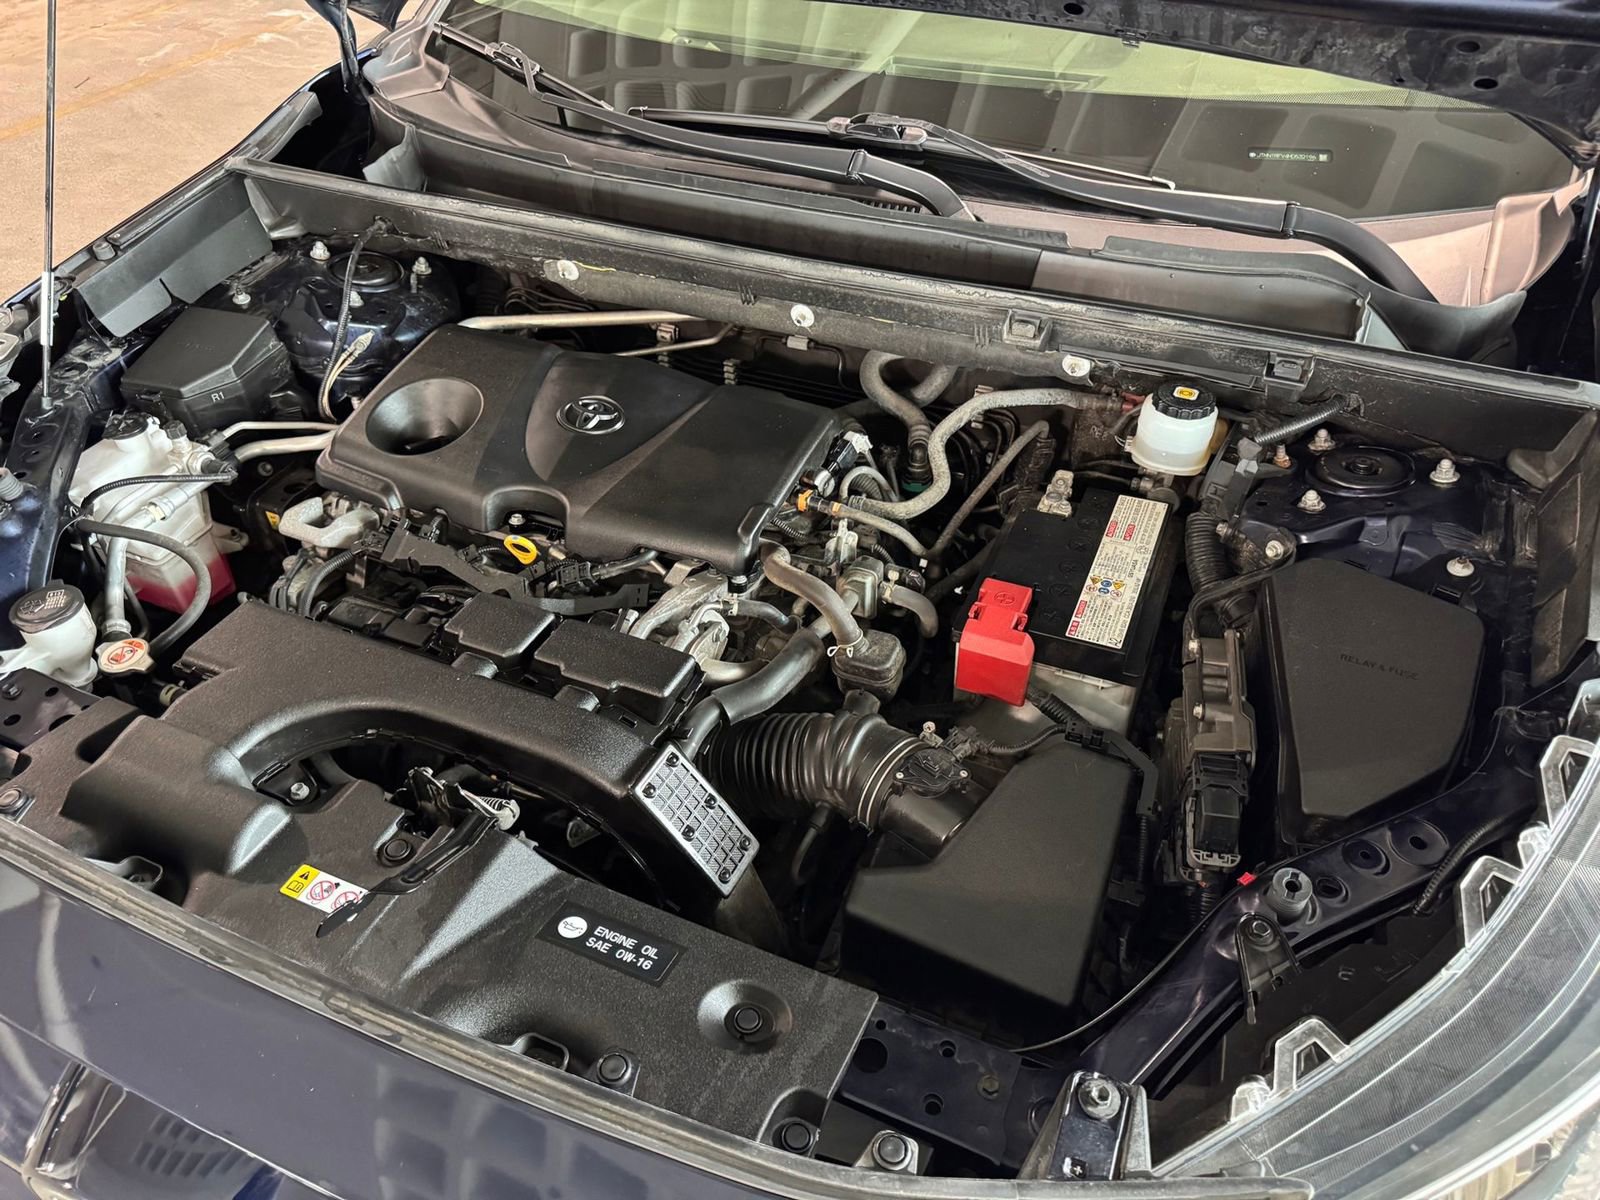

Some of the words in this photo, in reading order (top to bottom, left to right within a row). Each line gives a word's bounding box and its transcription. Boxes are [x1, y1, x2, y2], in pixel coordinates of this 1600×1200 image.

[211, 391, 225, 402] R1
[1340, 653, 1377, 669] RELAY
[585, 937, 613, 954] SAE
[615, 949, 653, 970] 0W-16
[593, 925, 638, 949] ENGINE
[641, 944, 658, 959] OIL
